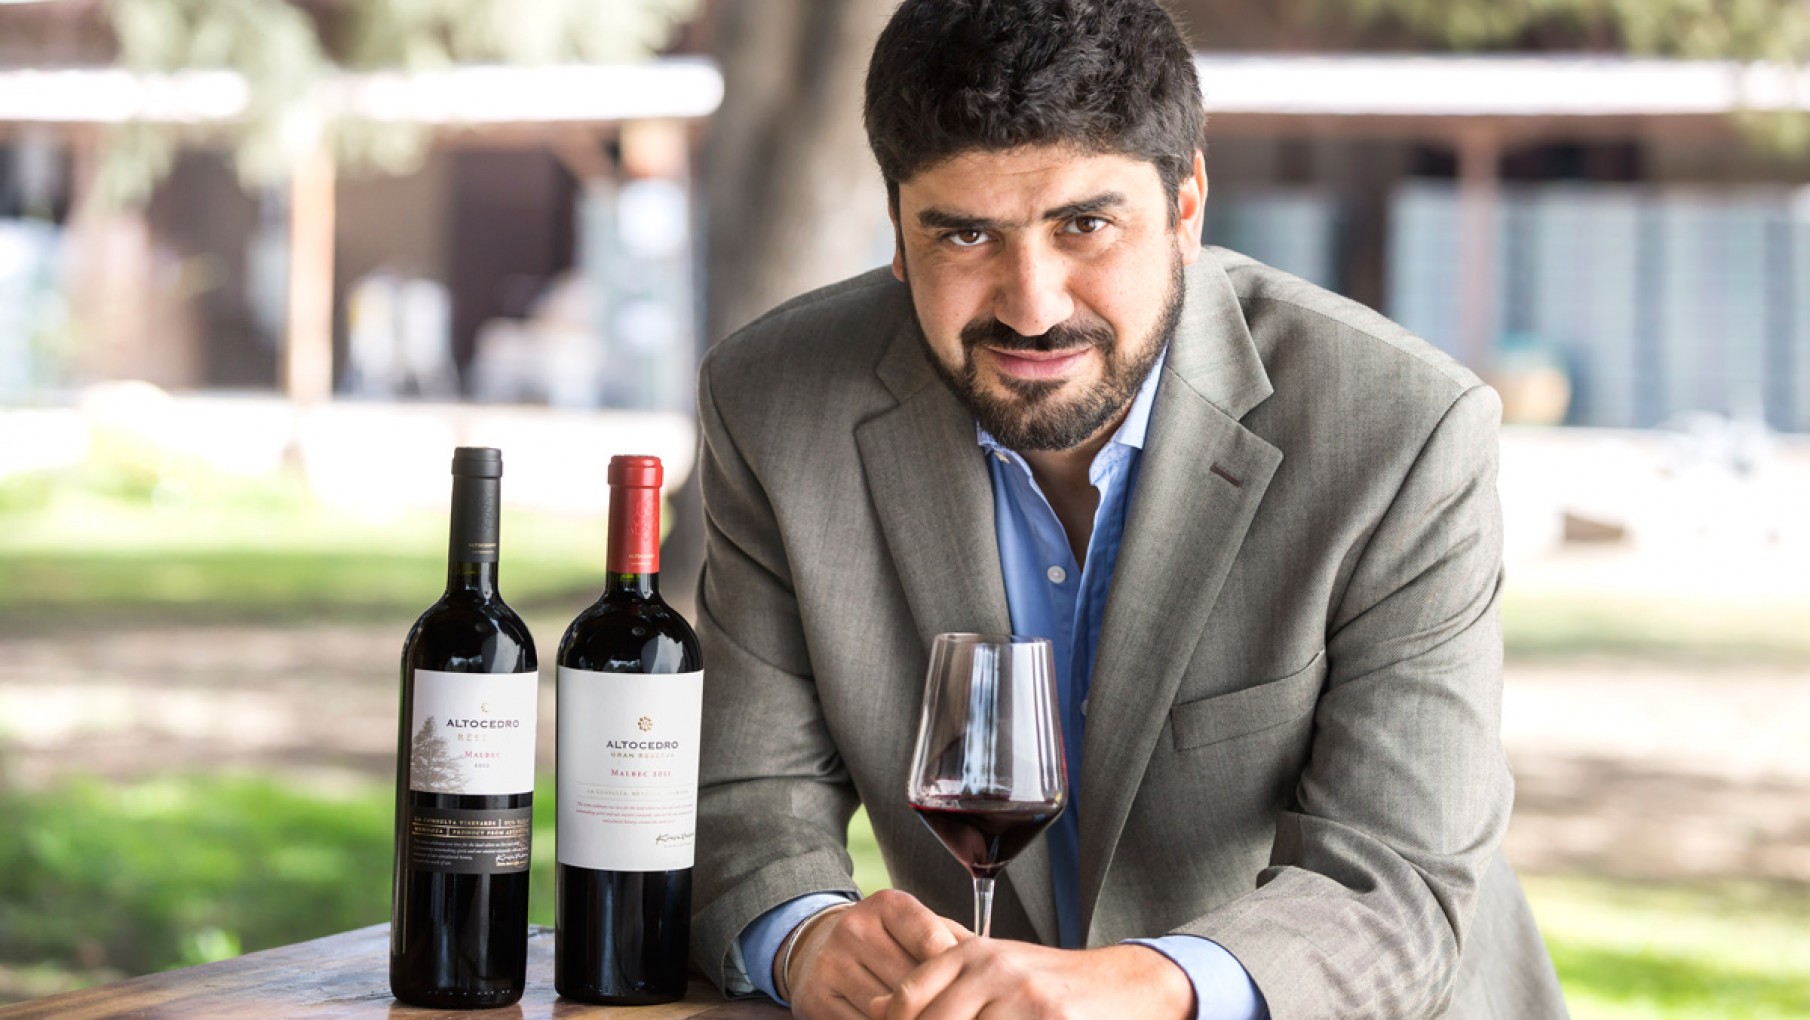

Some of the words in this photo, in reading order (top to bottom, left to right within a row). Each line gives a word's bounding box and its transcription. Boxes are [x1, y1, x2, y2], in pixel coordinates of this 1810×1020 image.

[446, 719, 520, 729] ALTOCEDRO
[606, 740, 679, 750] ALTOCEDRO
[610, 768, 649, 778] MALBEC
